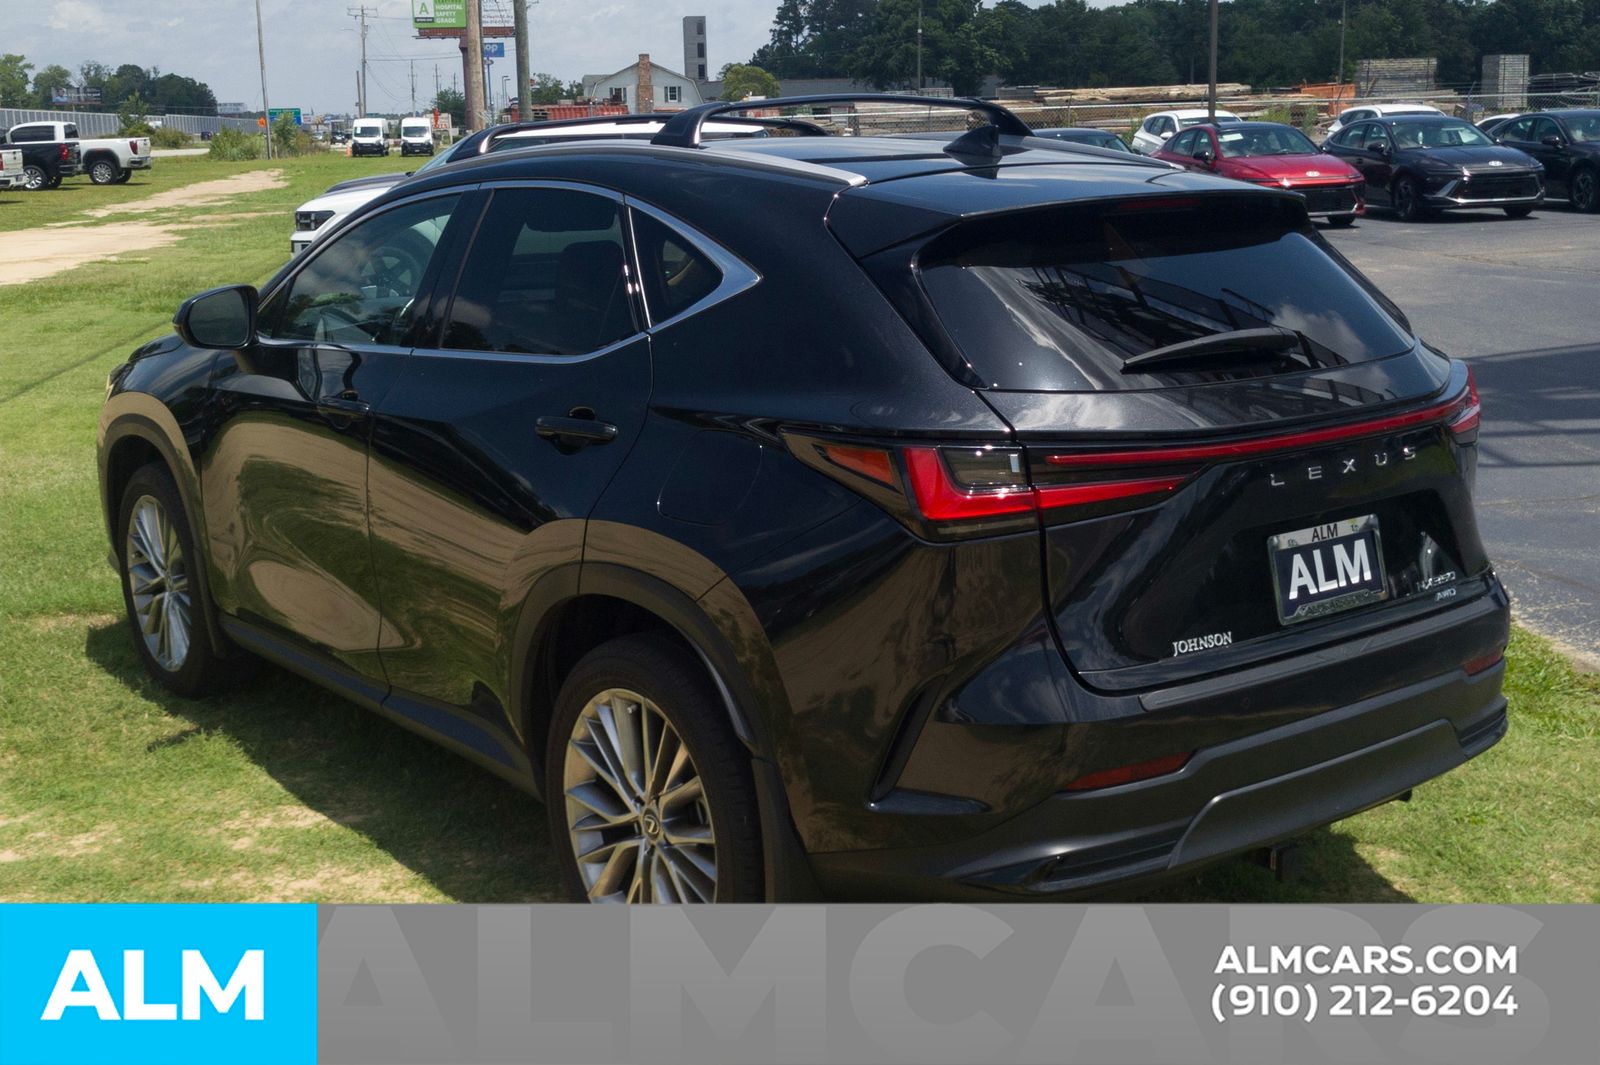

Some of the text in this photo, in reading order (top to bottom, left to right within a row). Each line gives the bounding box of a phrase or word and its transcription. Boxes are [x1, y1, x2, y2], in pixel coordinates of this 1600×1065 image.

[419, 2, 429, 15] A
[1270, 447, 1416, 486] LEXUS
[1311, 523, 1338, 542] ALM
[1289, 538, 1372, 600] ALM
[1435, 588, 1456, 601] AWD
[1172, 631, 1232, 657] JOHNSON
